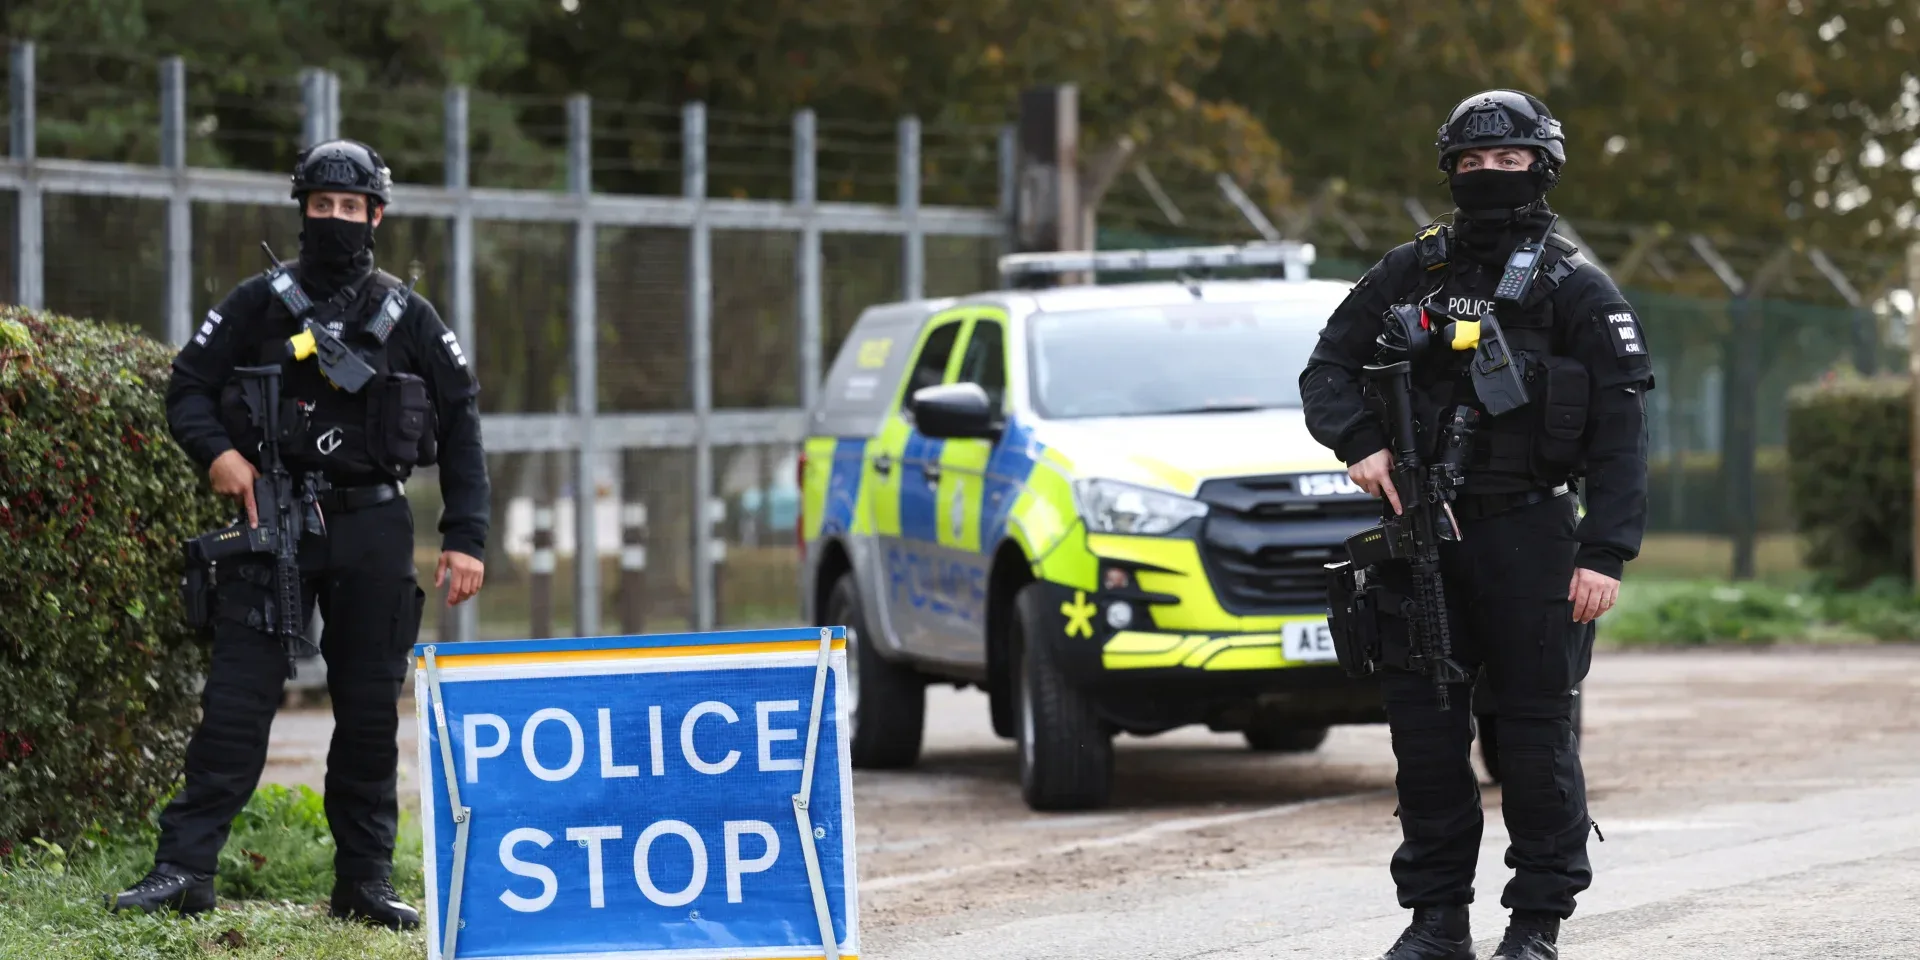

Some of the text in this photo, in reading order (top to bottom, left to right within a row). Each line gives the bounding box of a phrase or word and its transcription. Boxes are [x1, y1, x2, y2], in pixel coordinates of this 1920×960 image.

[1448, 297, 1496, 317] POLICE
[1608, 313, 1634, 324] POLICE
[1617, 326, 1636, 340] MD
[463, 700, 803, 784] POLICE
[499, 819, 781, 913] STOP
